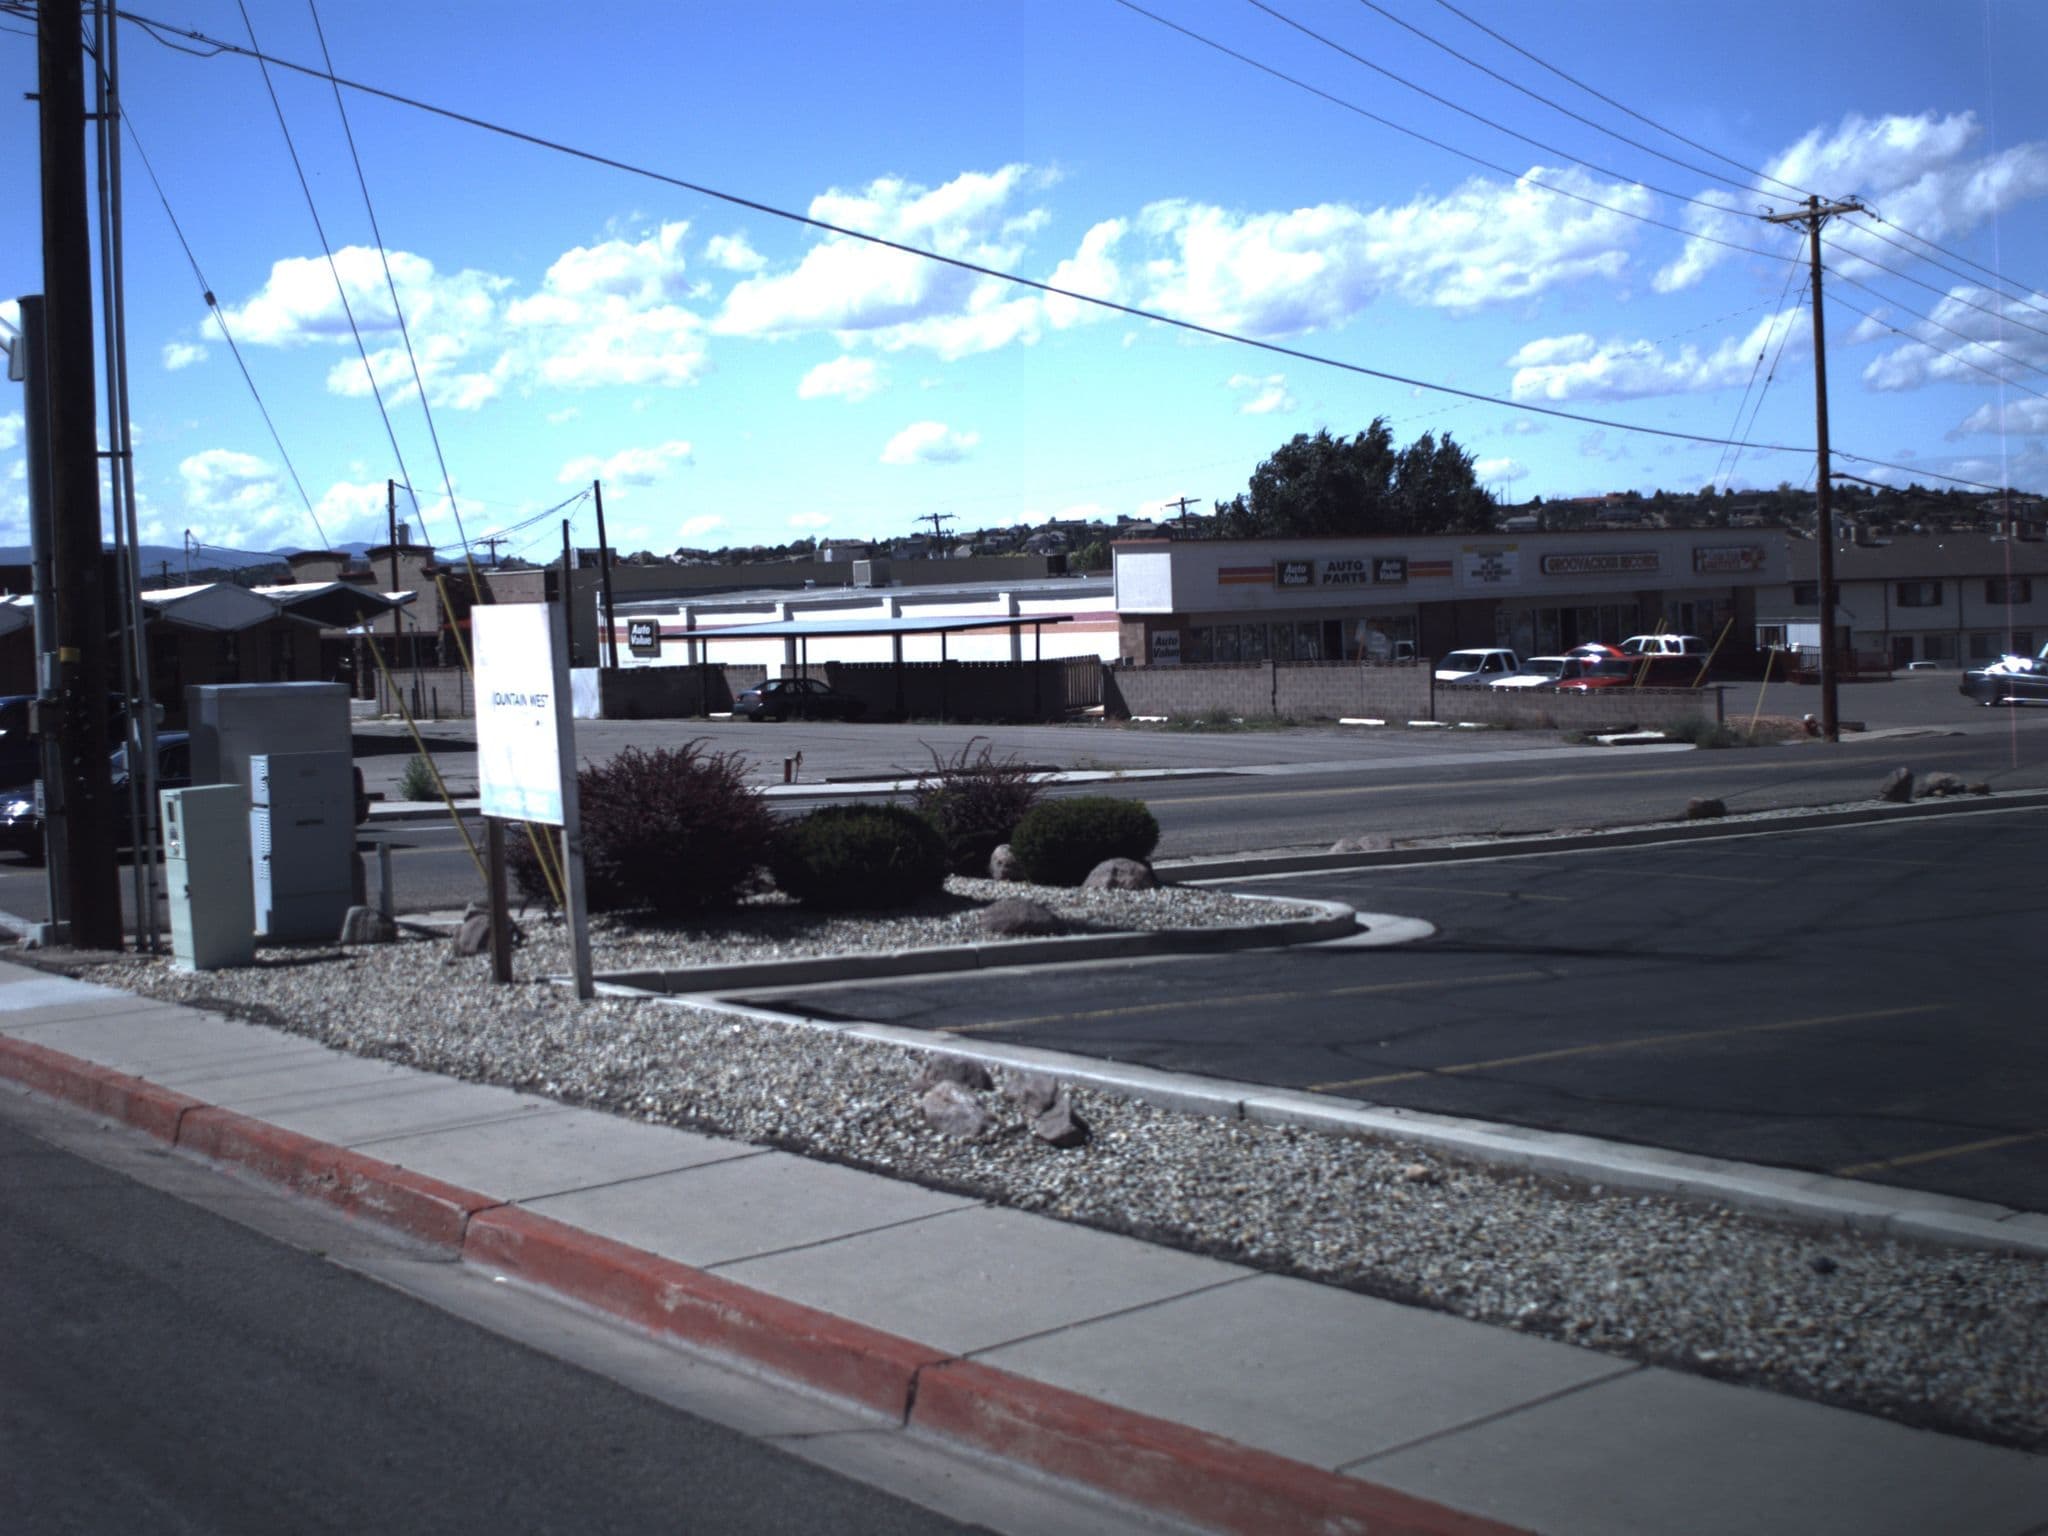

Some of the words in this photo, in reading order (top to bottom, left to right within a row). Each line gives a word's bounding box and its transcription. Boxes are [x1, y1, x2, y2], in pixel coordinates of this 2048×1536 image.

[1285, 563, 1306, 574] Auto
[1327, 560, 1363, 571] AUTO
[1381, 560, 1401, 570] Auto
[1283, 574, 1308, 584] Value
[1323, 572, 1366, 584] PARTS
[632, 624, 651, 634] Auto
[631, 635, 652, 646] Value
[1156, 636, 1177, 646] Auto
